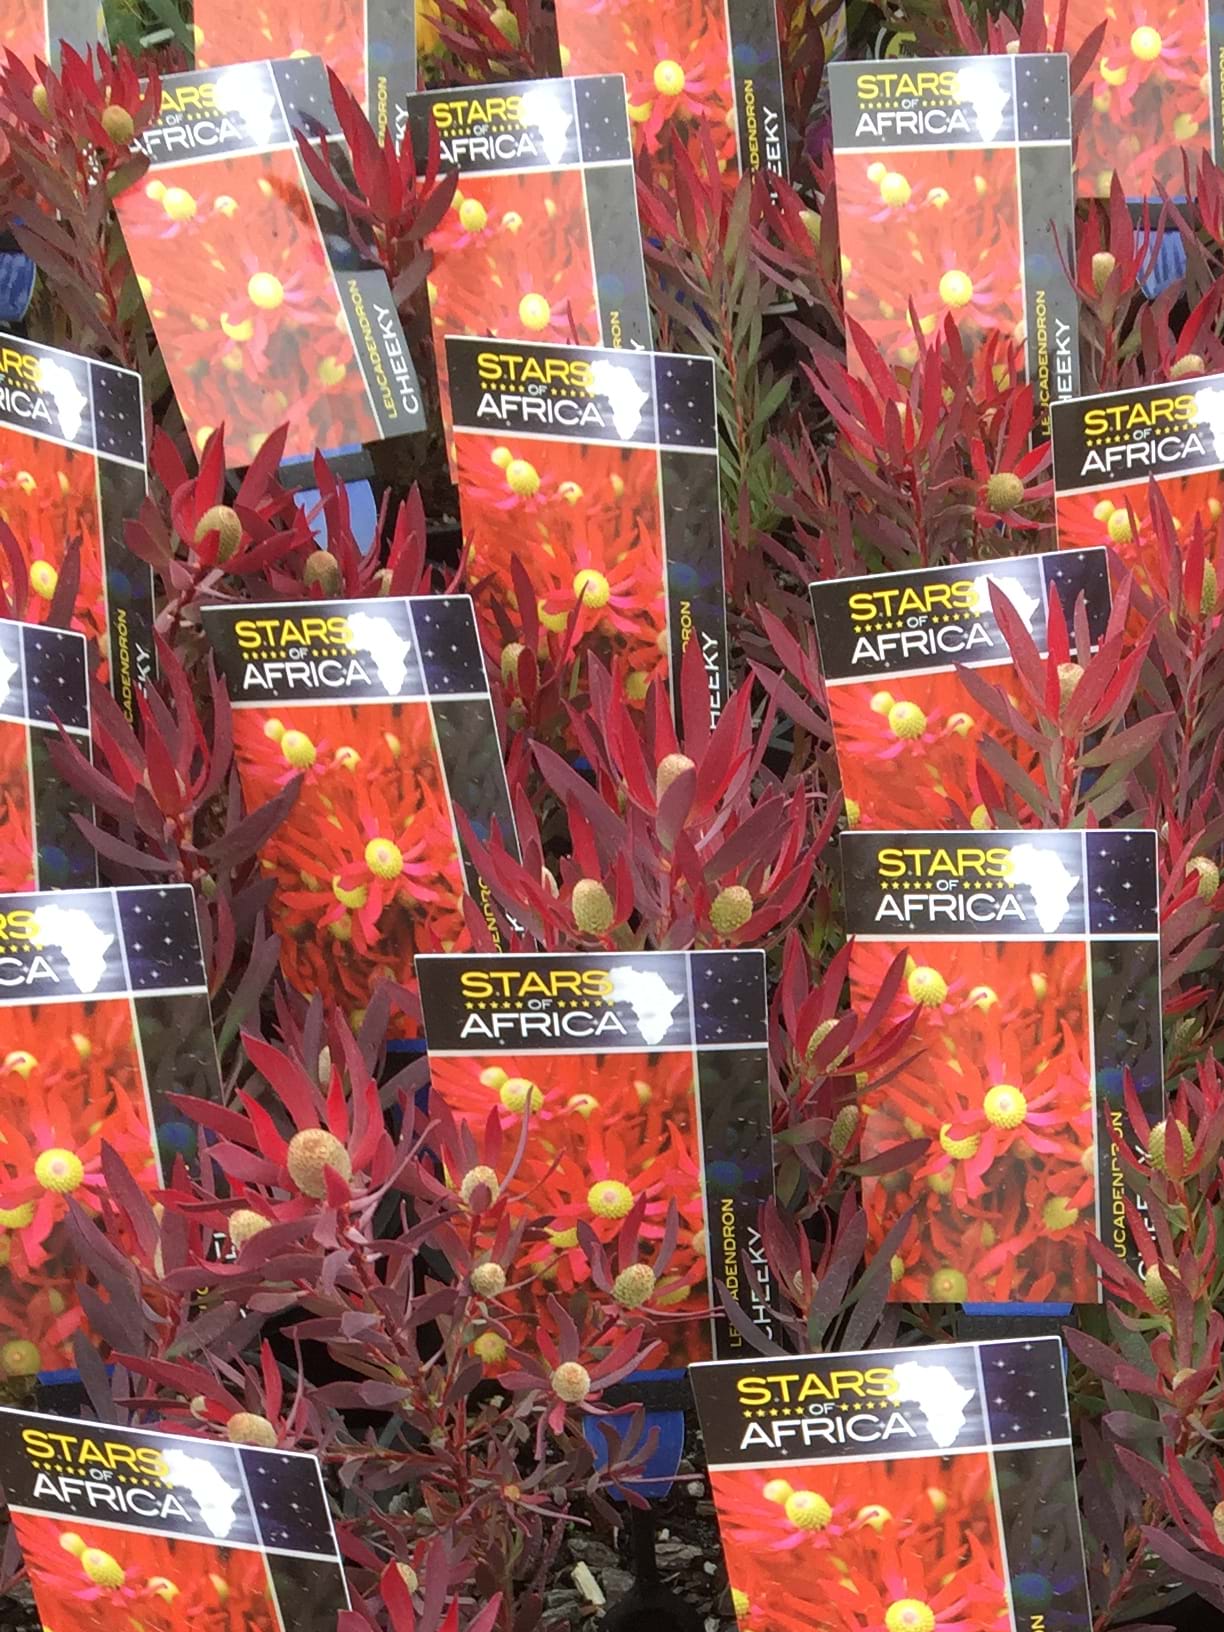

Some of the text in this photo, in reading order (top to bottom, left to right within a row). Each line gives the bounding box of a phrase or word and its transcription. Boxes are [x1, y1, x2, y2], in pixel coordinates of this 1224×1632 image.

[161, 85, 216, 110] ARS
[858, 73, 957, 99] STARS
[166, 114, 182, 125] OF
[432, 96, 524, 129] STARS
[902, 99, 918, 109] OF
[473, 124, 488, 136] OF
[745, 79, 760, 171] DENDRON
[856, 109, 971, 136] AFRICA
[763, 106, 782, 178] EEKY
[348, 279, 397, 418] LEUCADENDRON
[372, 303, 418, 414] CHEEKY
[1035, 290, 1052, 435] LECADENDRON
[1056, 318, 1073, 401] HEEKY
[477, 353, 595, 386] STARS
[528, 384, 547, 396] OF
[477, 393, 604, 426] AFRICA
[1084, 395, 1197, 436] STARS
[1133, 428, 1152, 440] OF
[1081, 434, 1204, 476] AFRICA
[848, 581, 978, 621] STARS
[235, 618, 352, 649] STARS
[907, 616, 928, 628] OF
[289, 648, 307, 659] OF
[852, 623, 993, 664] AFRICA
[117, 608, 133, 722] CADENDRON
[244, 660, 369, 689] AFRICA
[877, 848, 1013, 878] STARS
[937, 880, 959, 891] OF
[875, 894, 1025, 921] AFRICA
[461, 970, 613, 999] STARS
[528, 999, 552, 1010] OF
[461, 1011, 626, 1038] AFRICA
[721, 1198, 742, 1347] LEADENDRON
[737, 1368, 897, 1405] STARS
[809, 1403, 835, 1415] OF
[740, 1413, 916, 1449] AFRICA
[22, 1429, 168, 1477] STARS
[90, 1469, 113, 1481] OF
[33, 1475, 191, 1521] AFRICA
